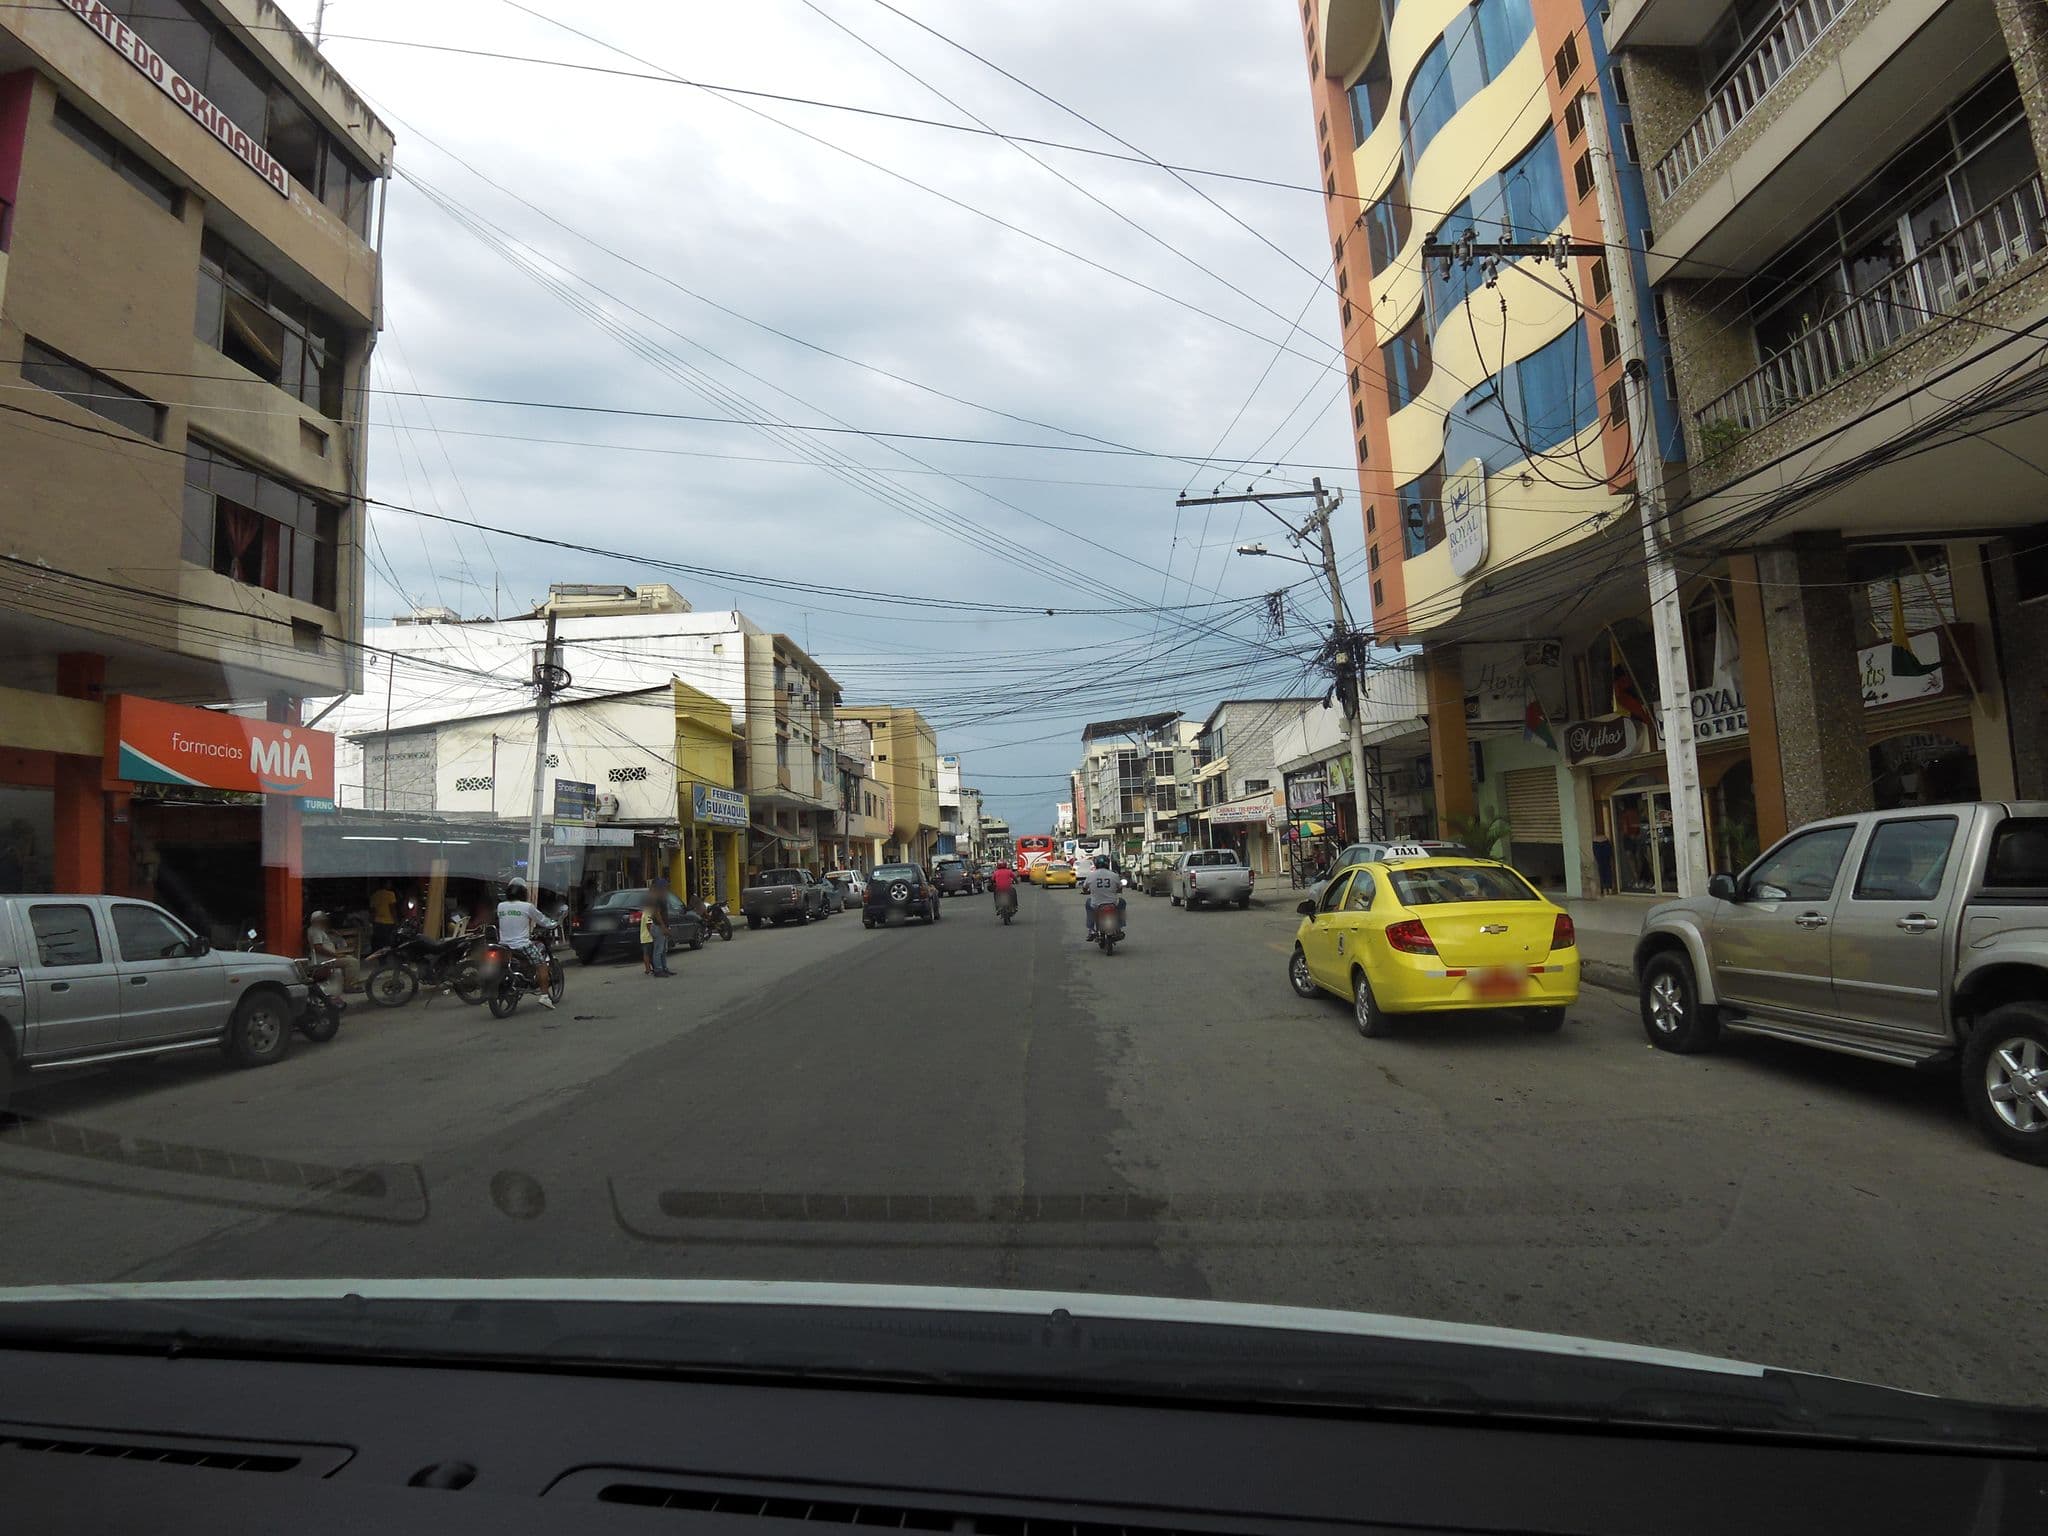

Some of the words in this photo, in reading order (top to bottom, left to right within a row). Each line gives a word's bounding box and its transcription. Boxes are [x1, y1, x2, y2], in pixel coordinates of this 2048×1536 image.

[171, 76, 285, 191] OKINAWA
[1450, 515, 1477, 549] ROYAL
[1452, 533, 1478, 558] HOTEL
[1691, 688, 1746, 718] OYAL
[1570, 726, 1622, 754] Mythos
[304, 799, 333, 811] TURNO
[706, 800, 748, 819] GUAYAQUIL
[1393, 847, 1418, 856] TAXI
[1096, 878, 1111, 888] 23
